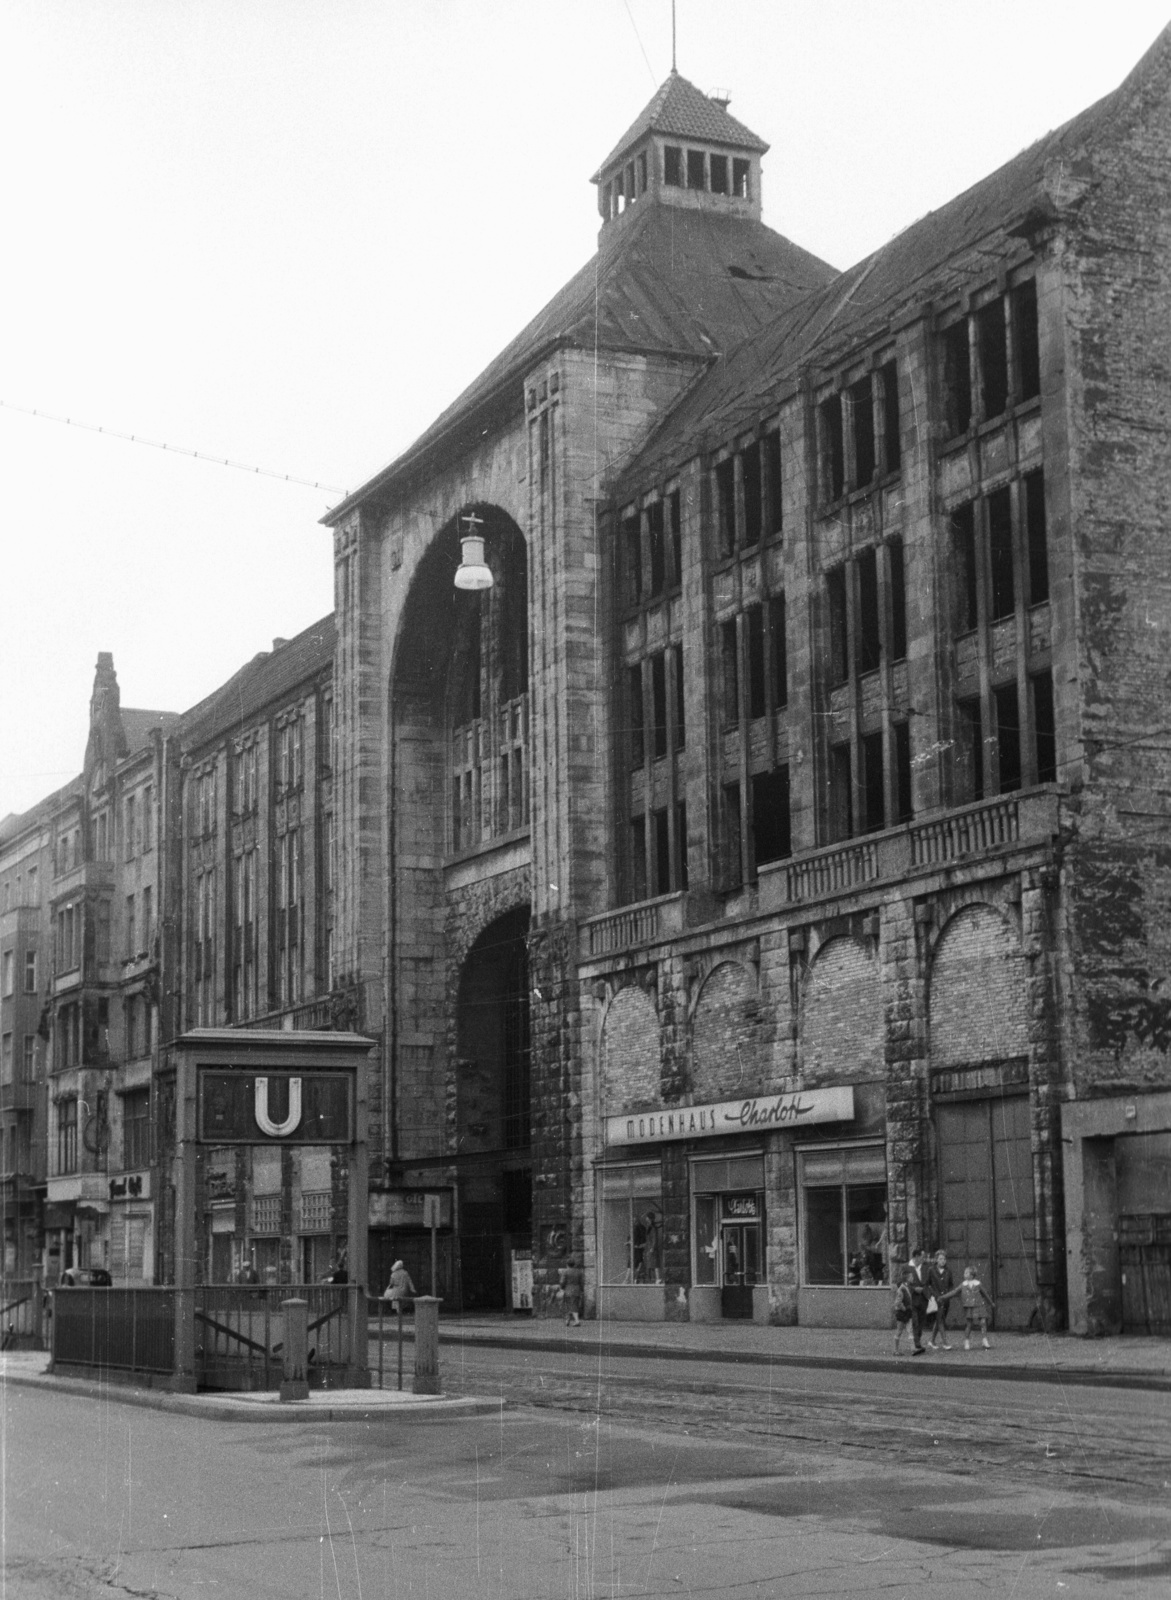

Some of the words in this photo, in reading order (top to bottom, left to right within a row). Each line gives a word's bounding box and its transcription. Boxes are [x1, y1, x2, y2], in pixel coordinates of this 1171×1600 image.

[254, 1076, 302, 1137] U
[626, 1108, 716, 1139] MODENHAUS
[725, 1095, 815, 1126] Charlott
